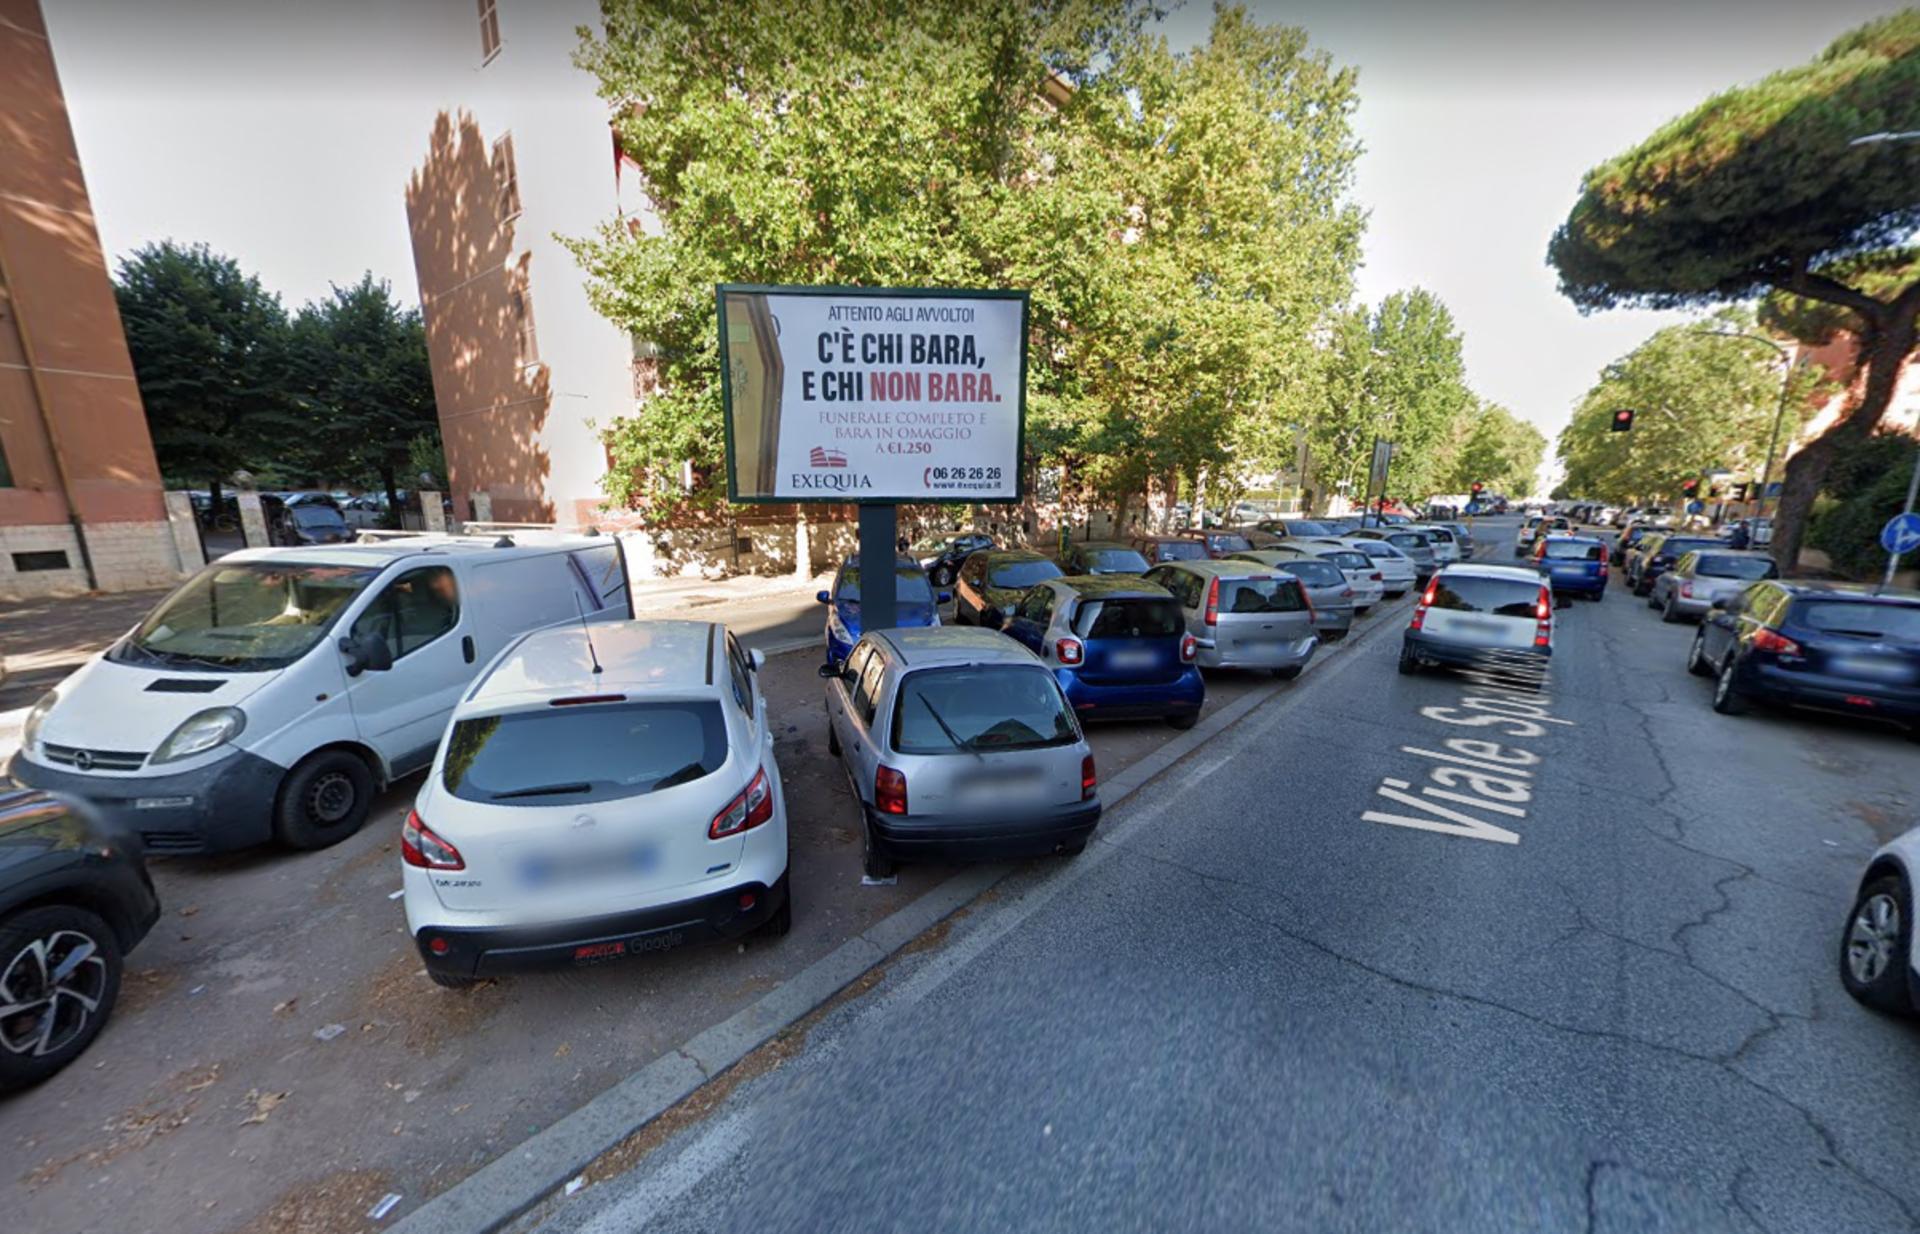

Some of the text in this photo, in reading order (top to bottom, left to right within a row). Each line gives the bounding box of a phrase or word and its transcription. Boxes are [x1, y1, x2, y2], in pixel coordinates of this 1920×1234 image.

[828, 305, 975, 323] ATTENTO AGLI AVVOLTOI
[817, 326, 986, 369] C'È CHI BARA,
[802, 371, 1002, 403] E CHI NON BARA.
[819, 411, 987, 425] FUNERALE COMPLETO E
[835, 427, 972, 440] BARA IN OMAGGIO
[876, 442, 932, 454] A €1.250
[933, 467, 1001, 479] 06 26 26 26
[792, 473, 872, 492] EXEQUIA
